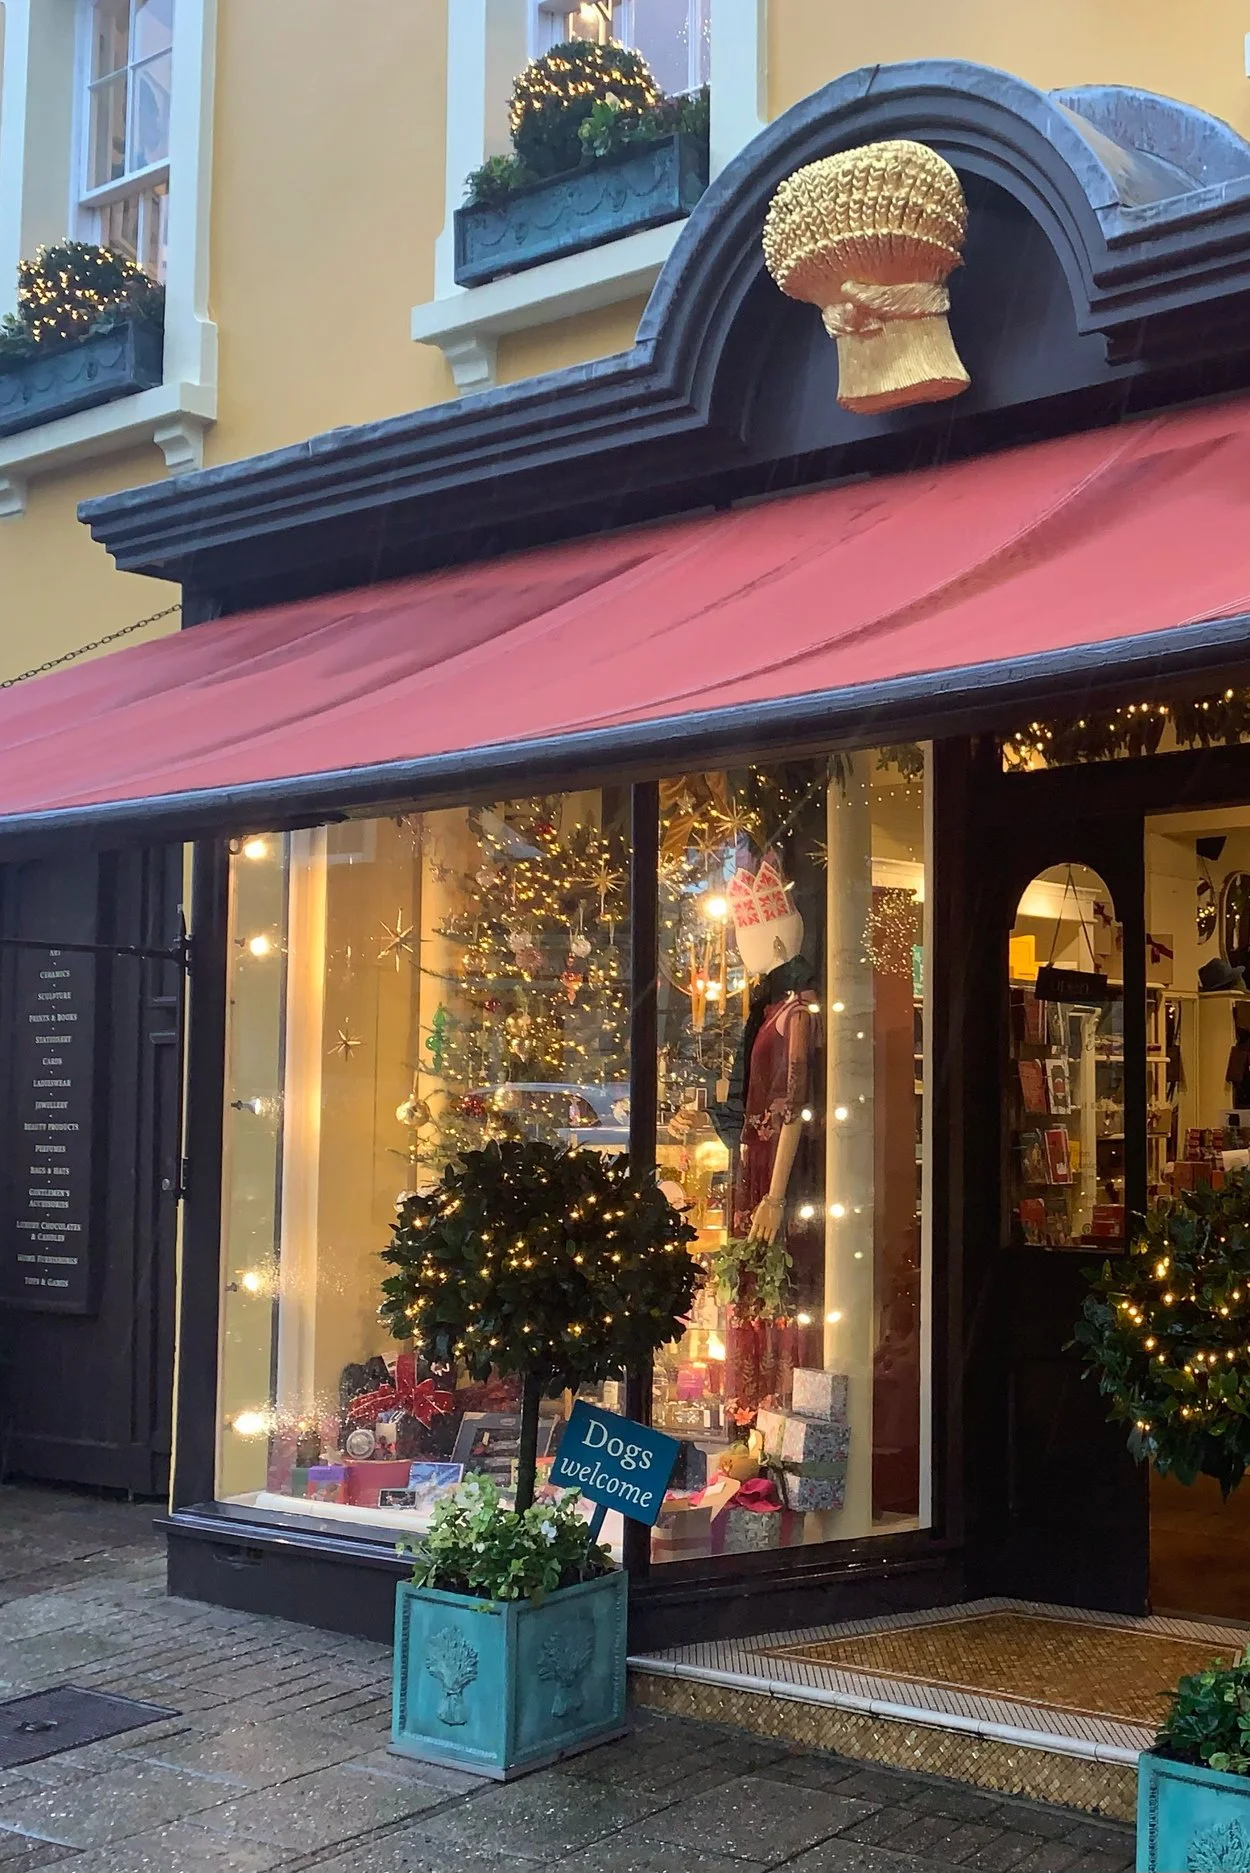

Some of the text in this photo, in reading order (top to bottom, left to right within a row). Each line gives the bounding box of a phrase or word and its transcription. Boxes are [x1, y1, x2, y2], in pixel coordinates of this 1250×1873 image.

[38, 991, 72, 1000] SCULPTURE
[57, 1013, 78, 1022] BOOKS
[35, 1036, 72, 1044] STATIONERY
[33, 1079, 71, 1087] LADIESWEAR
[35, 1101, 69, 1110] JEWELLERY
[48, 1123, 79, 1131] PRODUCTS
[581, 1419, 653, 1470] Dogs
[560, 1457, 653, 1508] welcome
